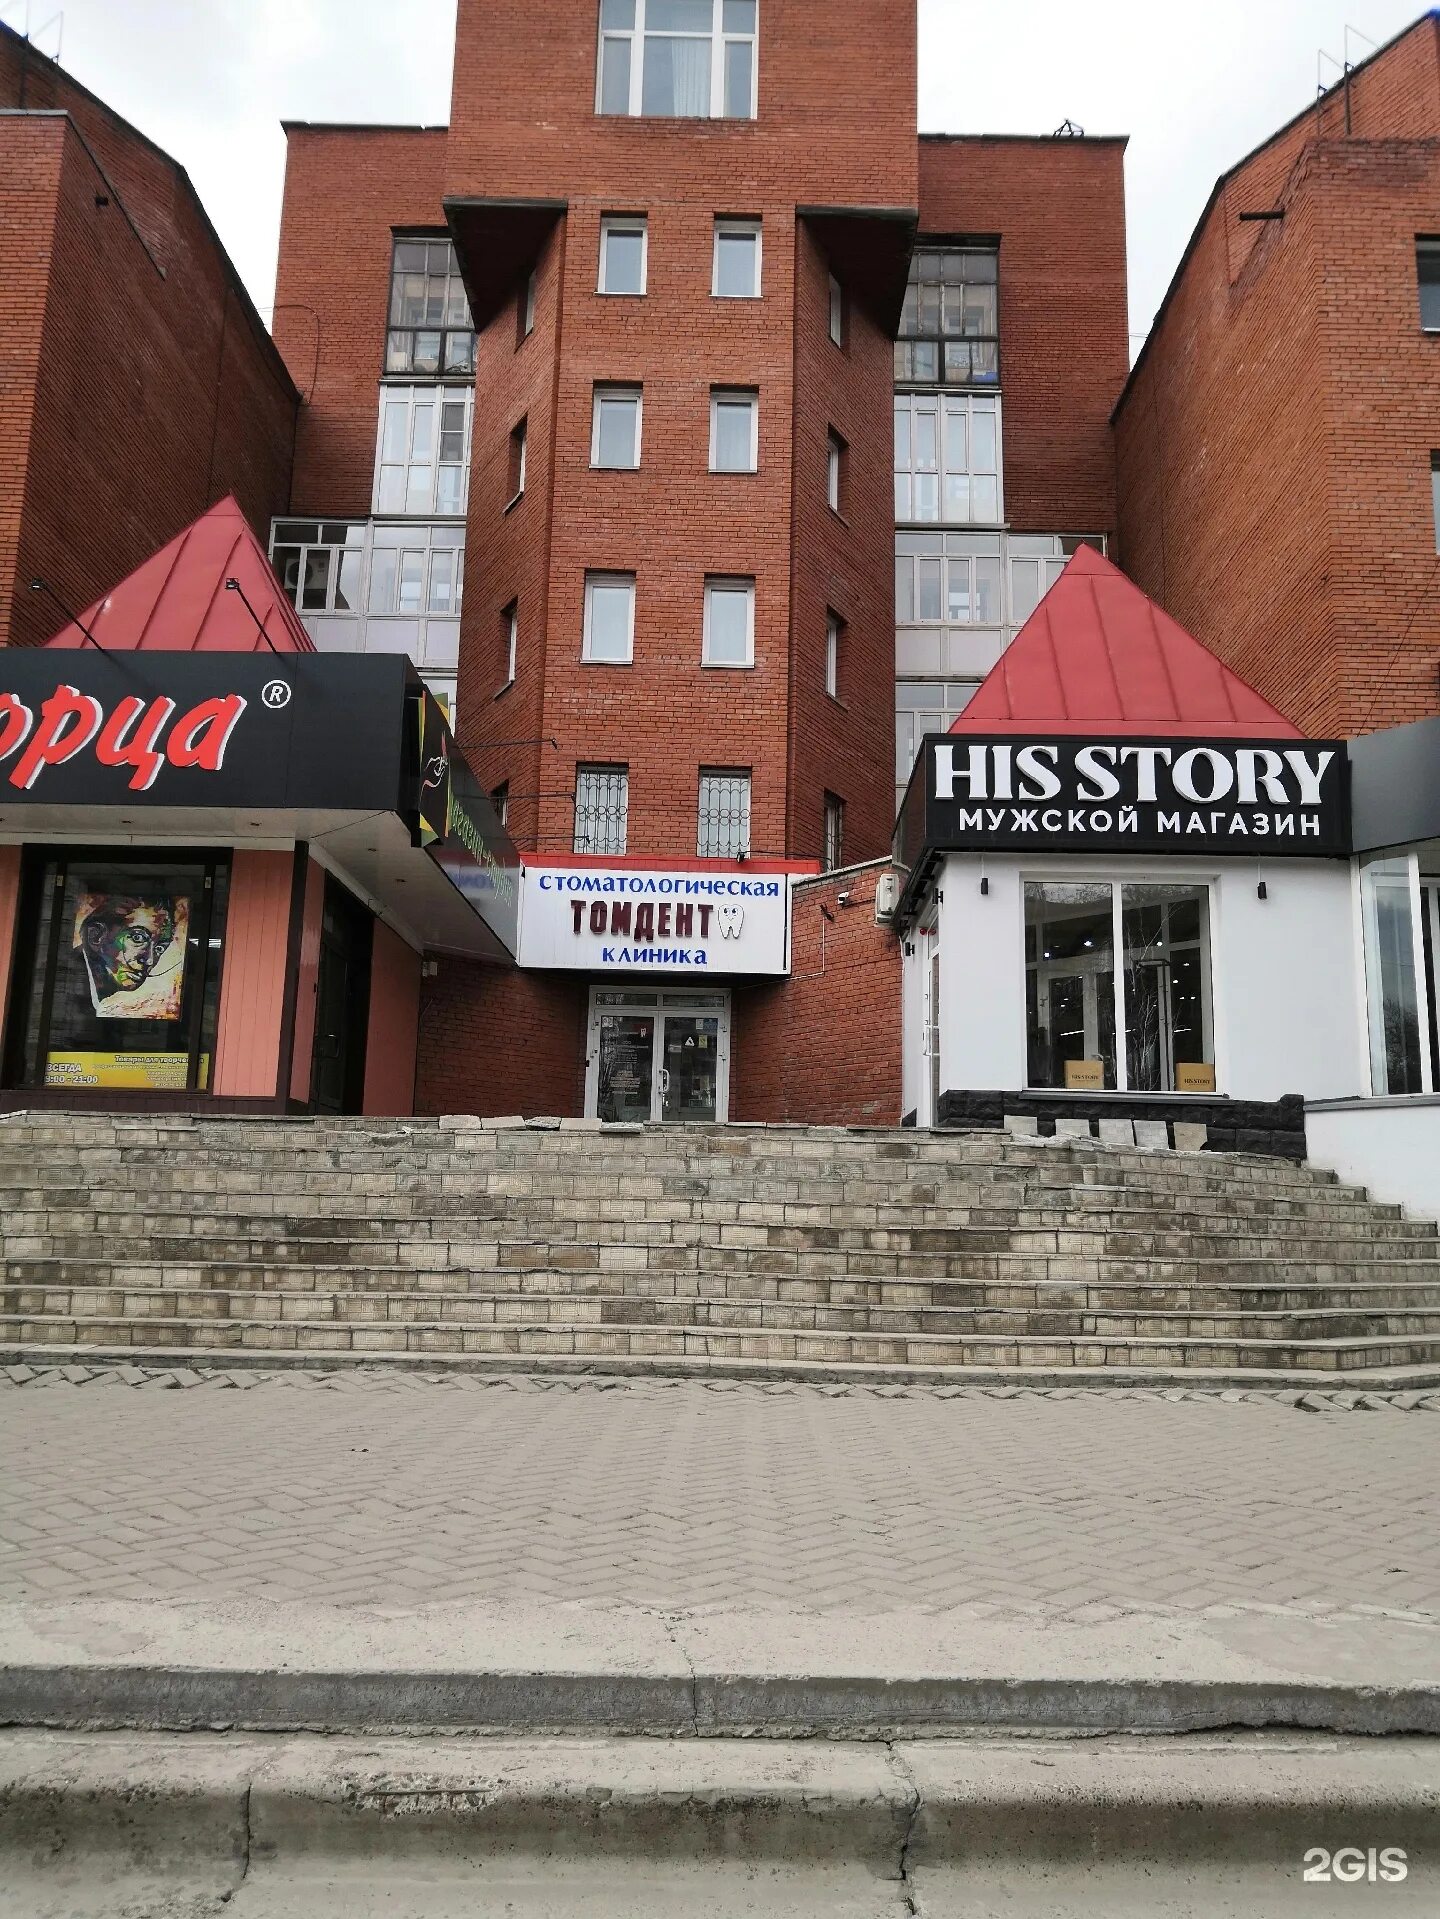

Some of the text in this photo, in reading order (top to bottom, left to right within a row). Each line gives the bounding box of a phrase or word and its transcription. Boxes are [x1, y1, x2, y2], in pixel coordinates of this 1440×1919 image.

[934, 745, 1336, 805] HIS STORY
[959, 805, 1321, 836] МУЖСКОЙ МАГАЗИН
[539, 874, 779, 897] стоматологическая
[570, 900, 714, 942] ТОМДЕНТ
[602, 947, 708, 965] клиника
[46, 1063, 82, 1073] ВСЕГДА
